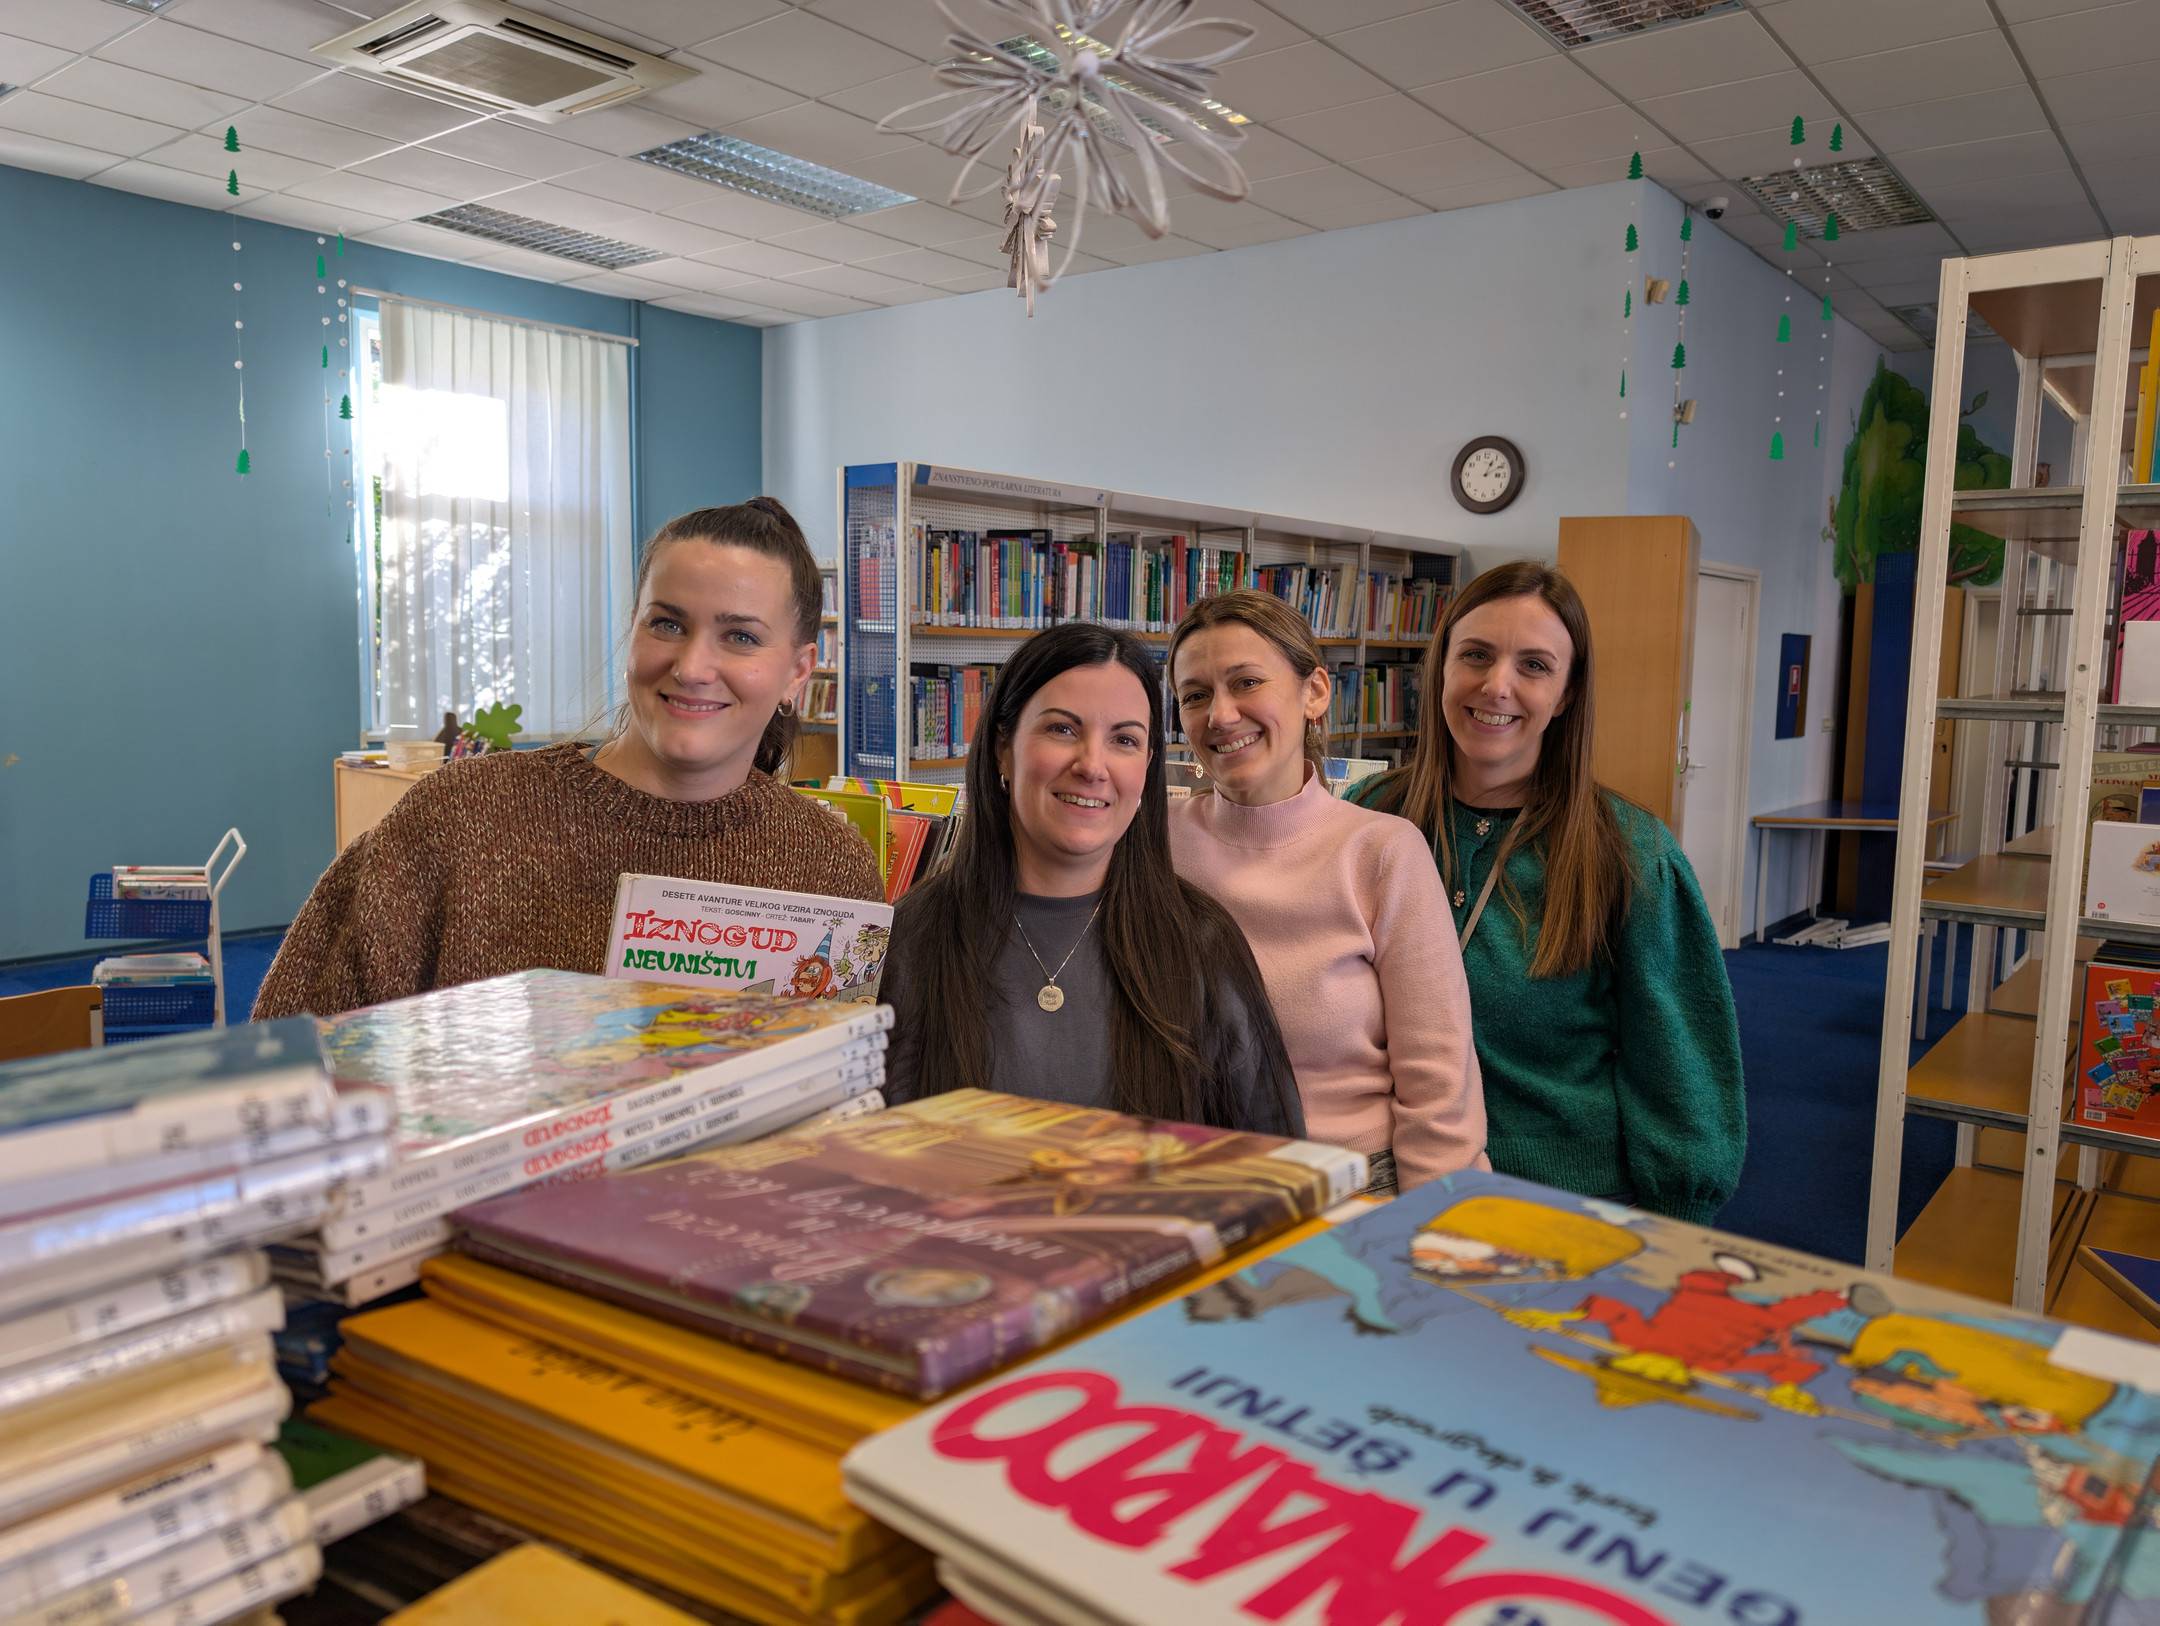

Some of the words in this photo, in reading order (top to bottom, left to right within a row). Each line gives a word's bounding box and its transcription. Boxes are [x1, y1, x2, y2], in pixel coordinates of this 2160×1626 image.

[933, 471, 1022, 492] ZNANSTVENO-POPULARNA
[1023, 483, 1062, 498] LITERATURA
[662, 889, 696, 901] DESETE
[697, 894, 743, 907] AVANTURE
[745, 899, 780, 911] VELIKOG
[782, 904, 811, 915] VEZIRA
[813, 907, 855, 920] IZNOGUDA
[701, 905, 724, 915] TEKST:
[725, 908, 761, 919] GOSCINNY
[789, 915, 816, 926] TABARY
[623, 909, 798, 954] IZNOGUD
[622, 947, 757, 980] NEUNIŠTIVI
[522, 1102, 613, 1148] IZNOGUD
[522, 1129, 613, 1177] IZNOGUD
[1169, 1365, 1413, 1477] ŠETNJI
[1427, 1470, 1498, 1512] U
[1522, 1508, 1802, 1626] GENIJ
